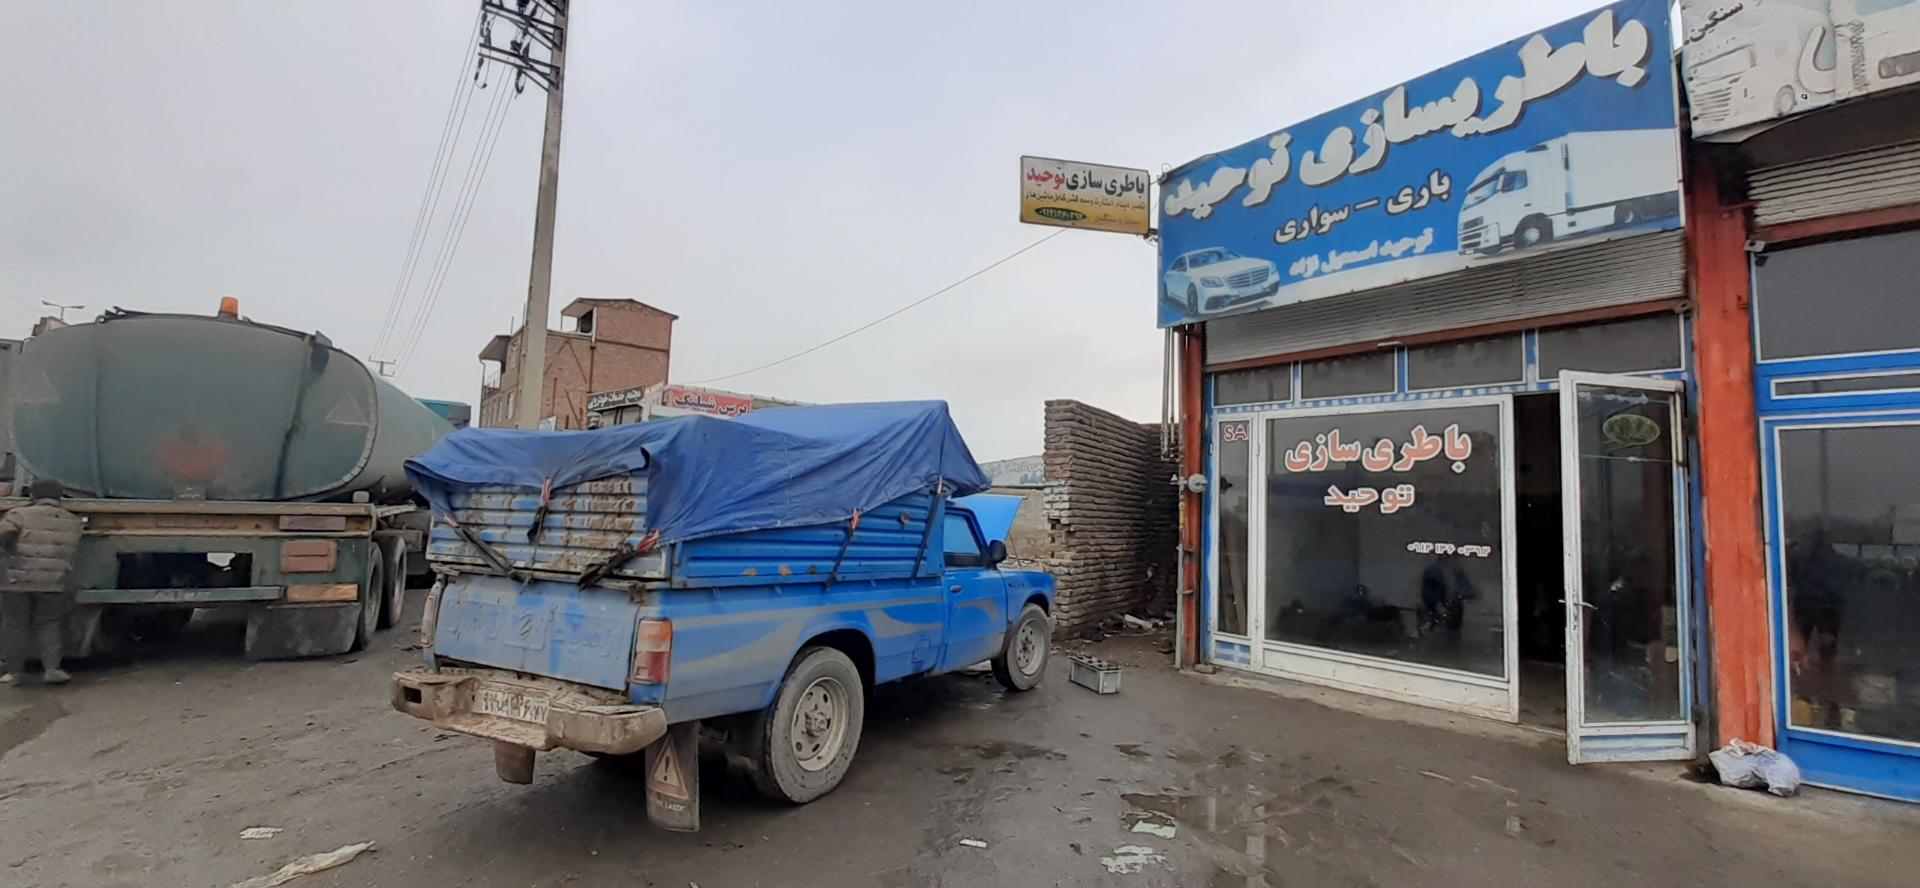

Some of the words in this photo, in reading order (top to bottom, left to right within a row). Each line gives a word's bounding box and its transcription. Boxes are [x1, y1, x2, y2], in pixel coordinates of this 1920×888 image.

[1689, 2, 1744, 42] سنگین
[1027, 166, 1065, 190] توحید
[1066, 170, 1103, 190] سازی
[1104, 174, 1145, 199] باطری
[1164, 131, 1293, 219] توحید
[1386, 170, 1453, 215] باری
[1274, 203, 1349, 244] سواری
[1379, 227, 1434, 258] توحید
[1285, 429, 1360, 473] سازی
[1362, 424, 1472, 473] باطری
[1324, 484, 1415, 514] توحید
